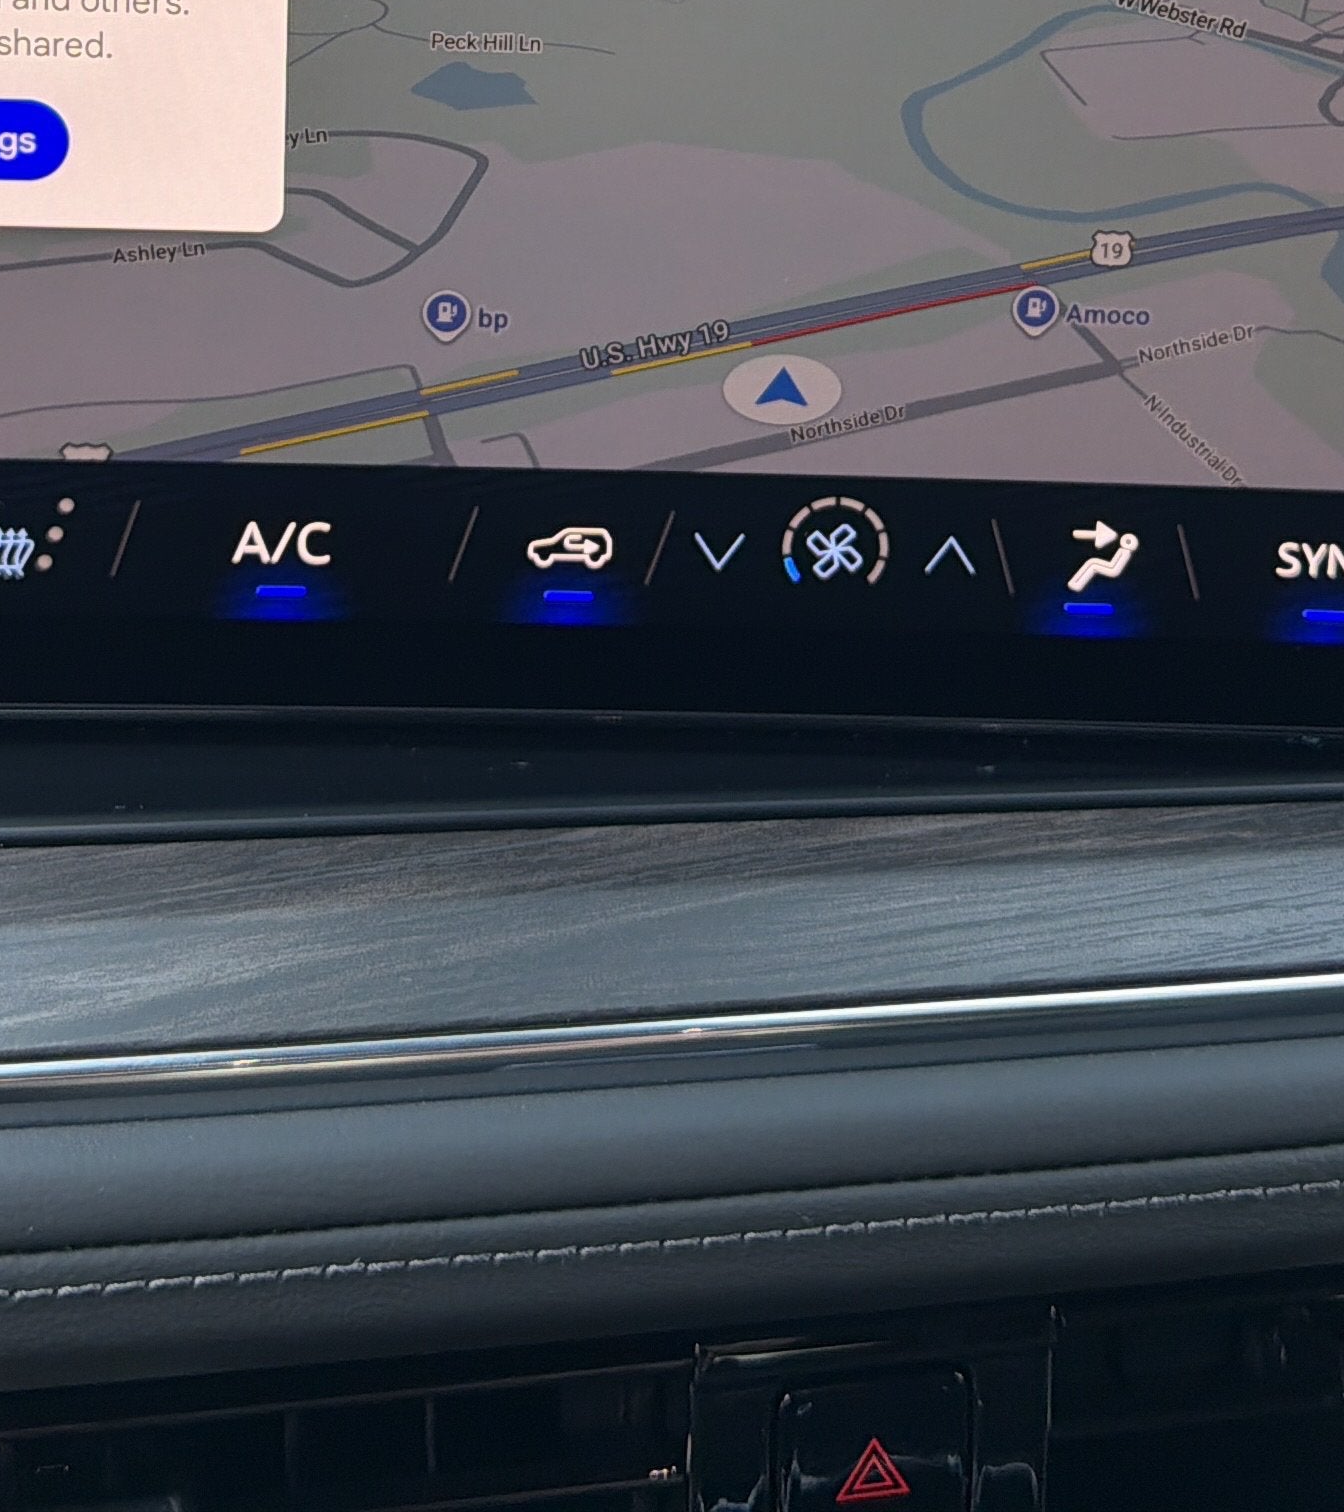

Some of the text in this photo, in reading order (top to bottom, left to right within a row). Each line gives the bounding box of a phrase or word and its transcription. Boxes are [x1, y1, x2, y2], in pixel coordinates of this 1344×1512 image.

[1218, 17, 1247, 38] Rd
[431, 32, 541, 52] Peck Hill Ln
[304, 128, 328, 144] Ln
[112, 238, 205, 267] Ashley Ln
[1100, 241, 1124, 260] 19
[478, 307, 509, 334] bp
[1066, 304, 1150, 328] Amoco
[579, 321, 730, 370] U.S. Hwy 19
[1139, 324, 1254, 365] Northside Dr
[790, 404, 905, 444] Northside Dr
[1144, 394, 1243, 485] N Industrial Dr
[232, 522, 330, 564] A/C
